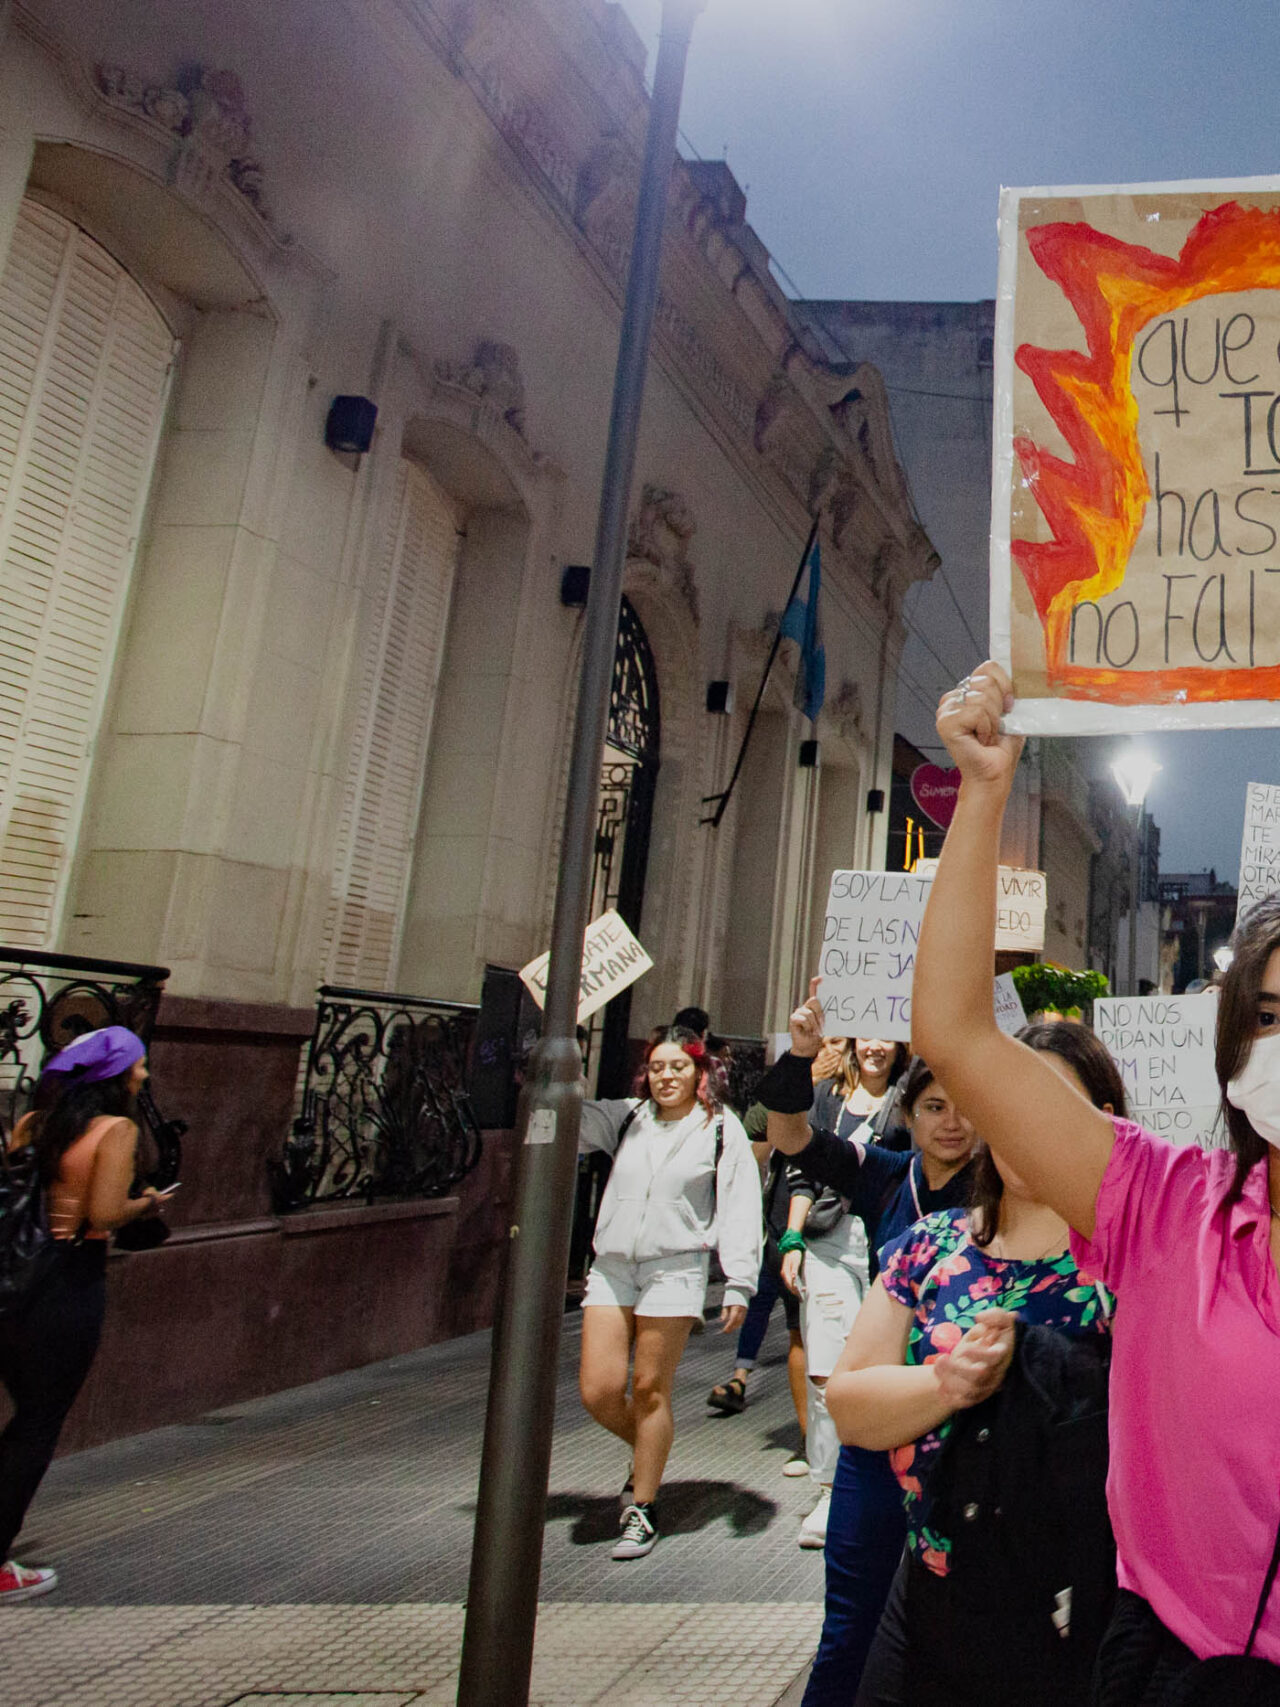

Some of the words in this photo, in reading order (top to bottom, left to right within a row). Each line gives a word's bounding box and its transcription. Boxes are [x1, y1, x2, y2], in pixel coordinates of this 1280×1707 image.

[1138, 313, 1259, 428] que
[1069, 600, 1140, 668] no
[1250, 825, 1273, 843] TE
[832, 873, 879, 902] SOY
[880, 876, 910, 901] LA
[1001, 877, 1041, 898] VIVIR
[823, 916, 852, 942] DE
[858, 917, 900, 944] LAS
[825, 949, 880, 977] QUE
[860, 998, 879, 1021] A
[1100, 1004, 1132, 1028] NO
[1137, 1002, 1182, 1025] NOS
[1172, 1027, 1203, 1048] UN
[1149, 1055, 1176, 1079] EN
[1123, 1086, 1187, 1107] ALMA
